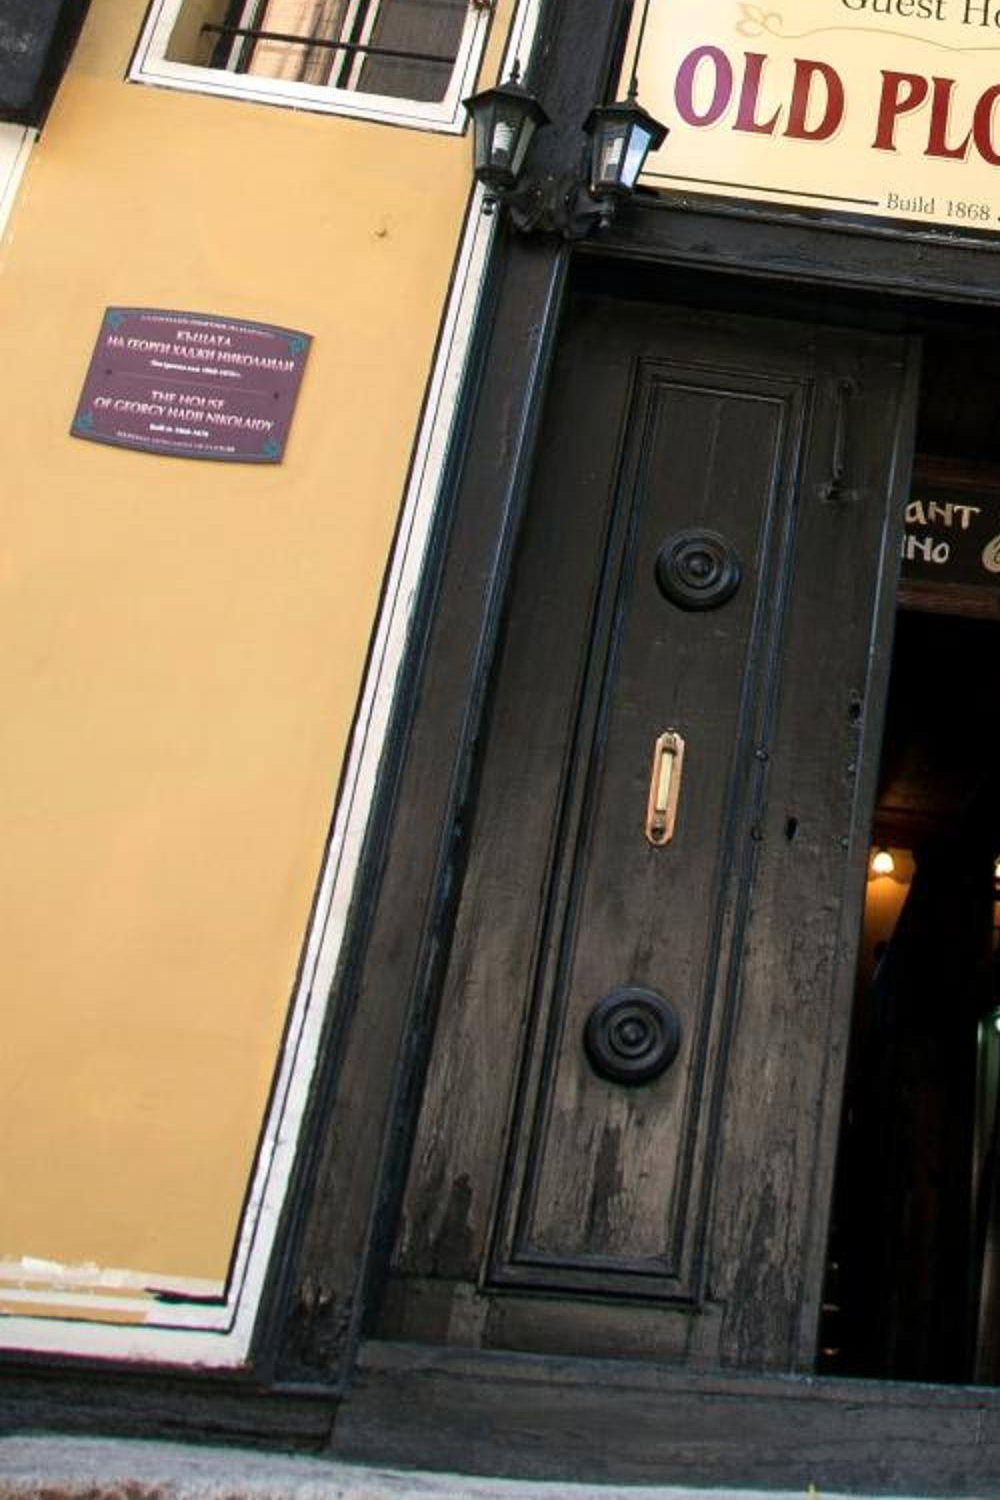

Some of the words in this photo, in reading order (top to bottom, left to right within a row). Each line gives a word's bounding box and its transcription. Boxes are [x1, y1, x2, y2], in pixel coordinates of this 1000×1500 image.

[674, 45, 846, 141] OLD
[886, 193, 936, 216] Build
[946, 200, 991, 222] 1868
[94, 396, 113, 409] OF
[114, 398, 166, 416] GEORGY
[151, 390, 176, 402] THE
[179, 394, 226, 410] HOUSE
